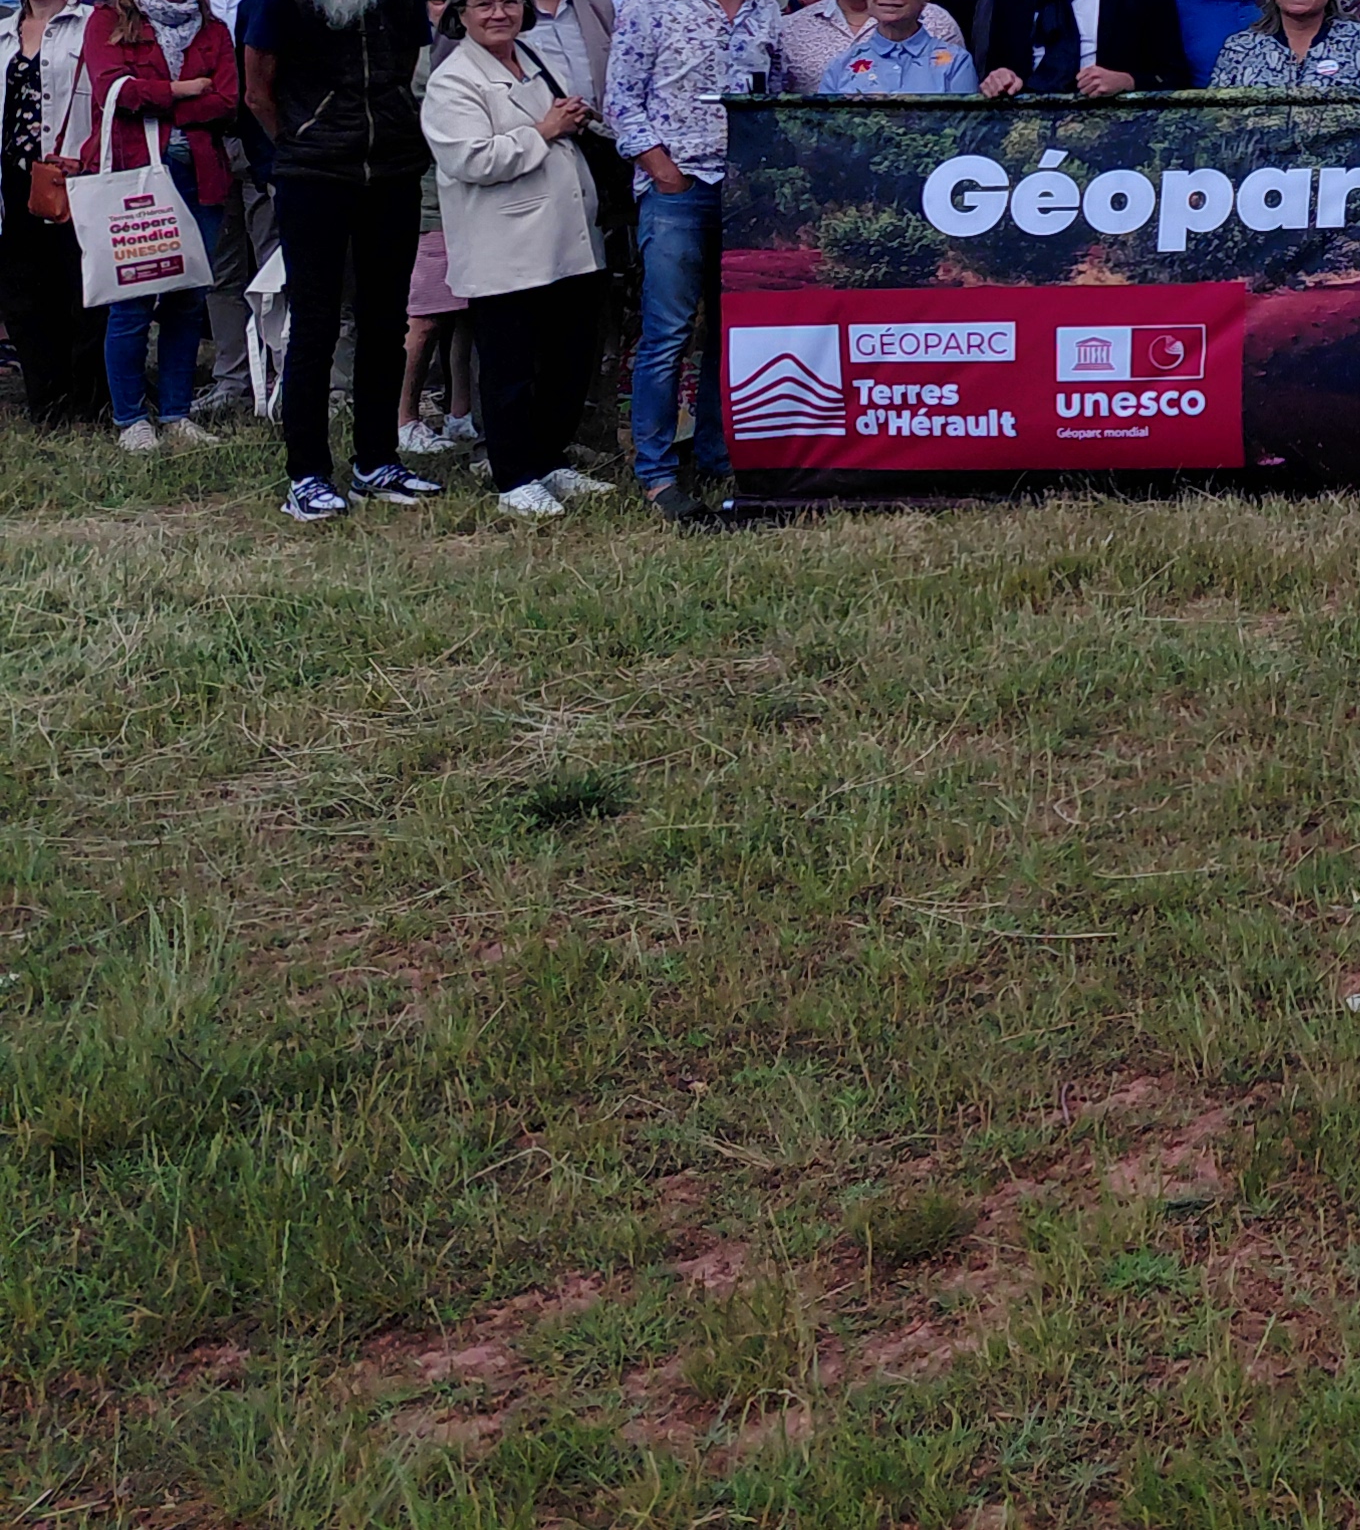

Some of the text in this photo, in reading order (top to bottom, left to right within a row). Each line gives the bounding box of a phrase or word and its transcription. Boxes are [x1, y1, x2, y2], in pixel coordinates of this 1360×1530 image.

[110, 216, 177, 234] Géoparc
[112, 227, 179, 247] Mondial
[114, 241, 181, 260] UNESCO
[855, 328, 1009, 356] GÉOPARC
[853, 379, 959, 405] Terres
[1056, 390, 1206, 418] unesco
[855, 408, 1017, 437] d'Hérault
[1056, 426, 1149, 439] Géoparc mondial
